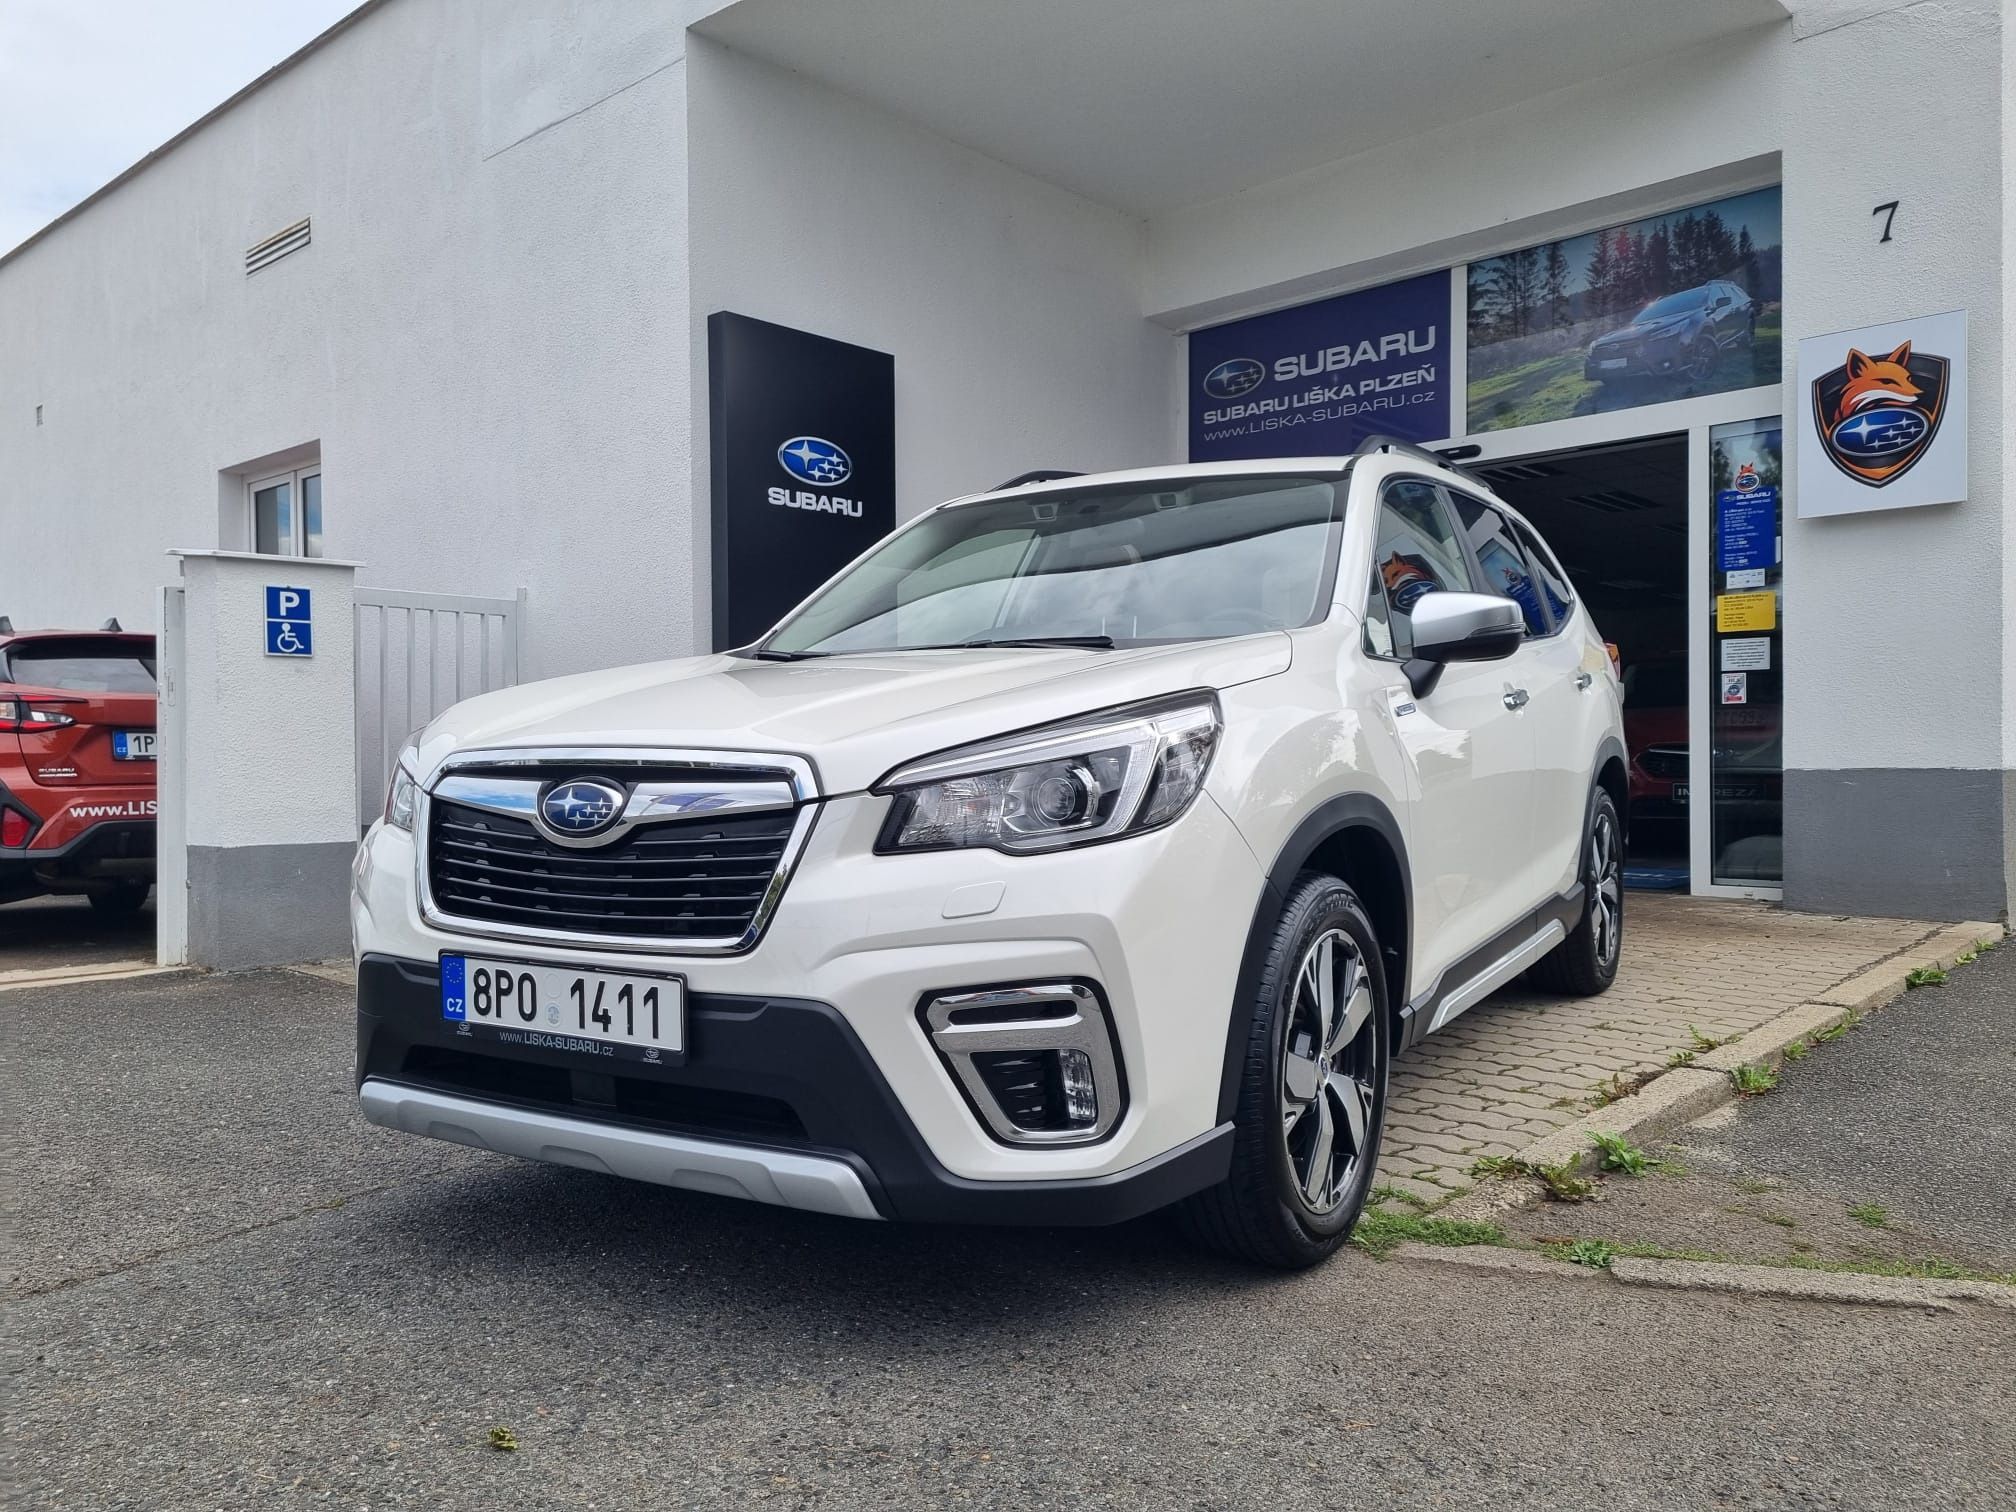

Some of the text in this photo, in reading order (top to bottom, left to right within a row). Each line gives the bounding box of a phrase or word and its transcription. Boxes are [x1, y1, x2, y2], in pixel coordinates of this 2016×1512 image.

[1872, 200, 1900, 244] 7
[1273, 325, 1437, 382] SUBARU
[1203, 363, 1437, 426] SUBARU LIŠKA PLZEŇ
[1203, 390, 1437, 442] www.LISKA-SUBARU.cz
[767, 486, 863, 518] SUBARU
[279, 591, 301, 616] P
[132, 735, 158, 753] 1P
[446, 997, 464, 1014] CZ
[570, 978, 660, 1040] 1411
[499, 1031, 614, 1057] www.LISKA-SUBARU.cz
